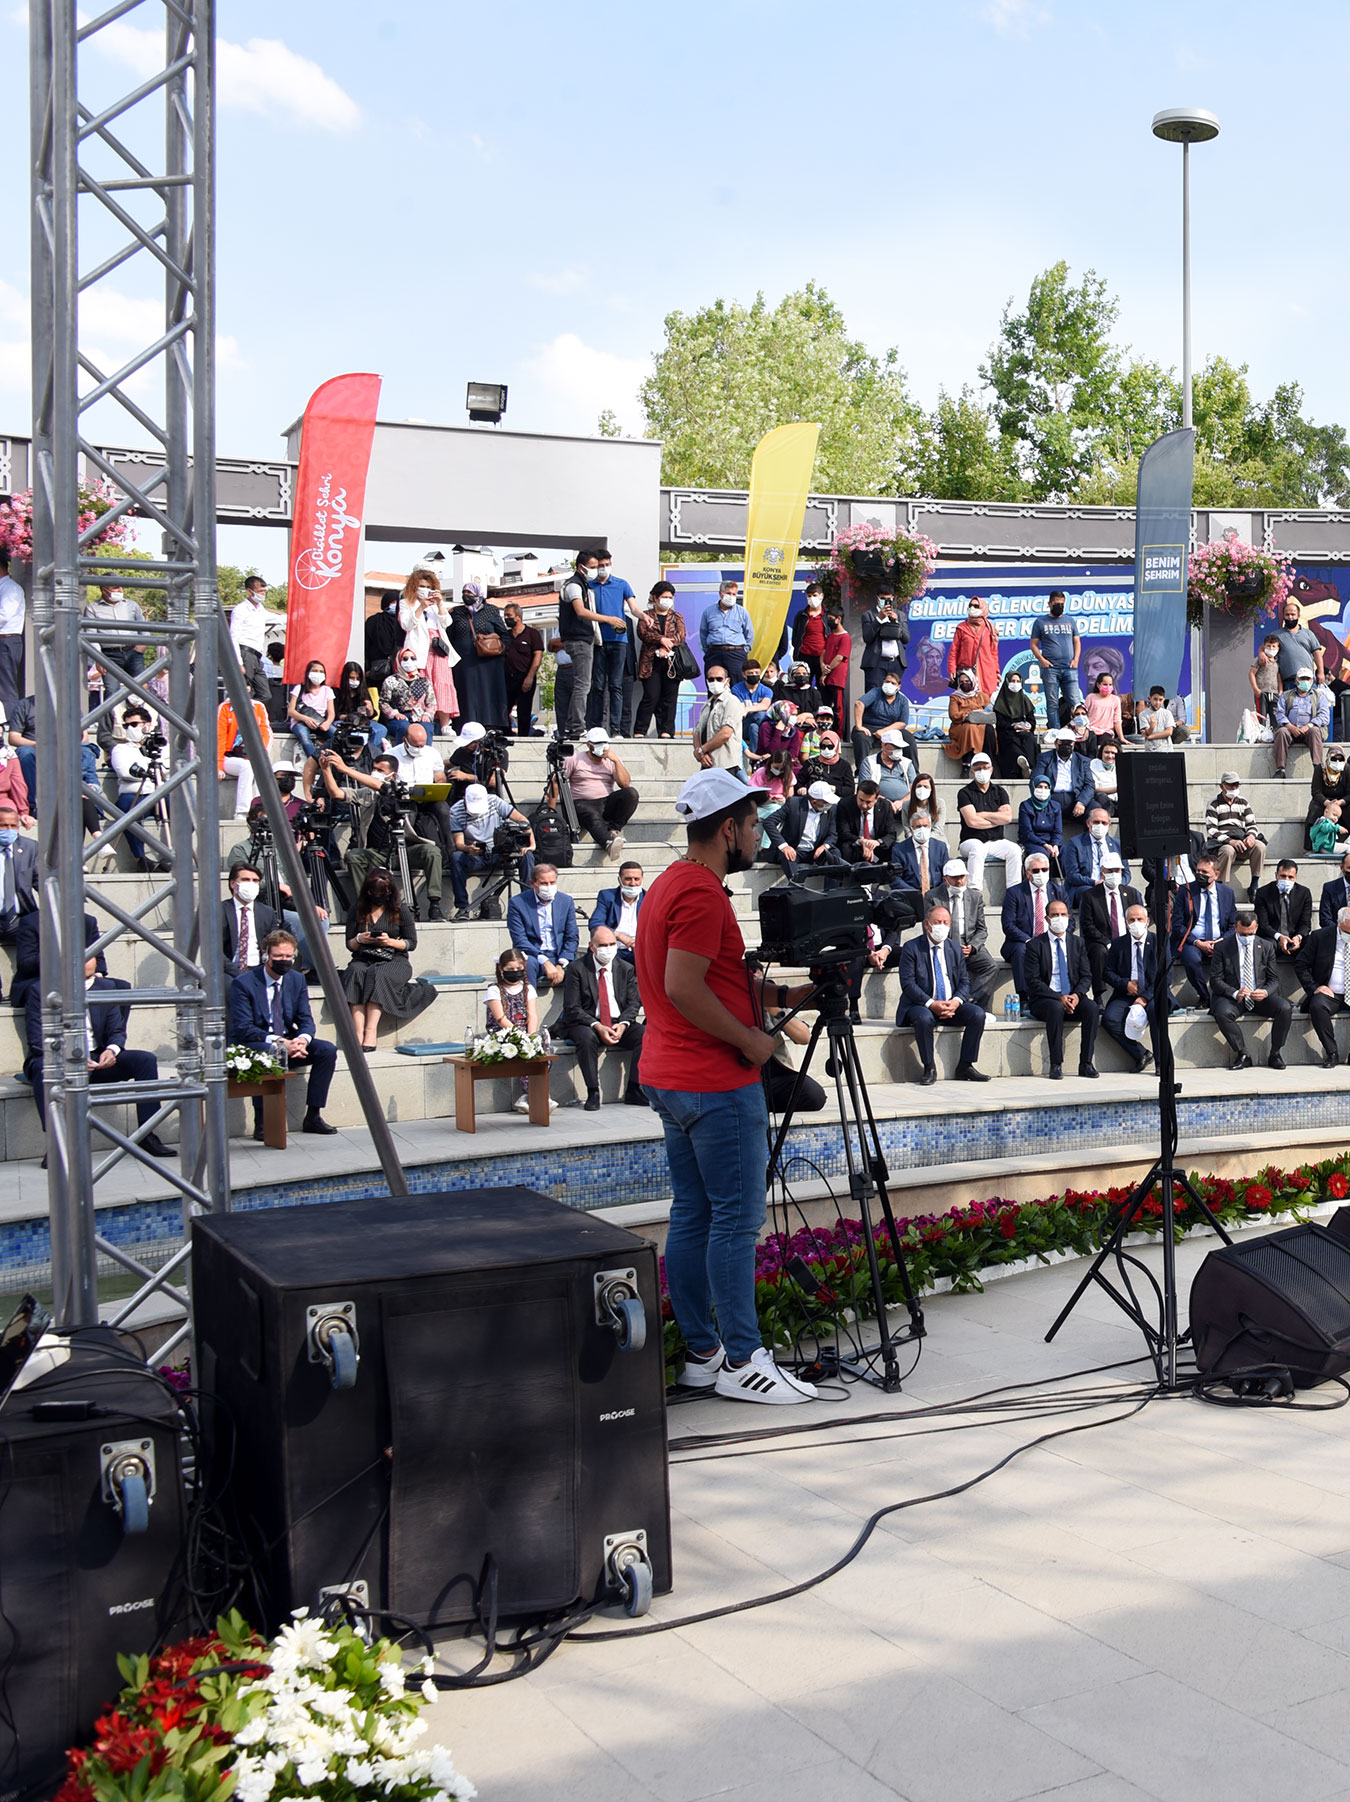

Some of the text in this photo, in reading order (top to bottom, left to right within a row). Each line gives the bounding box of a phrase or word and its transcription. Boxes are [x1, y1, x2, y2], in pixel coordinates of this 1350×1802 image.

[315, 488, 360, 578] Konya
[1145, 557, 1180, 569] BENİM
[1144, 569, 1180, 582] ŞEHRİM
